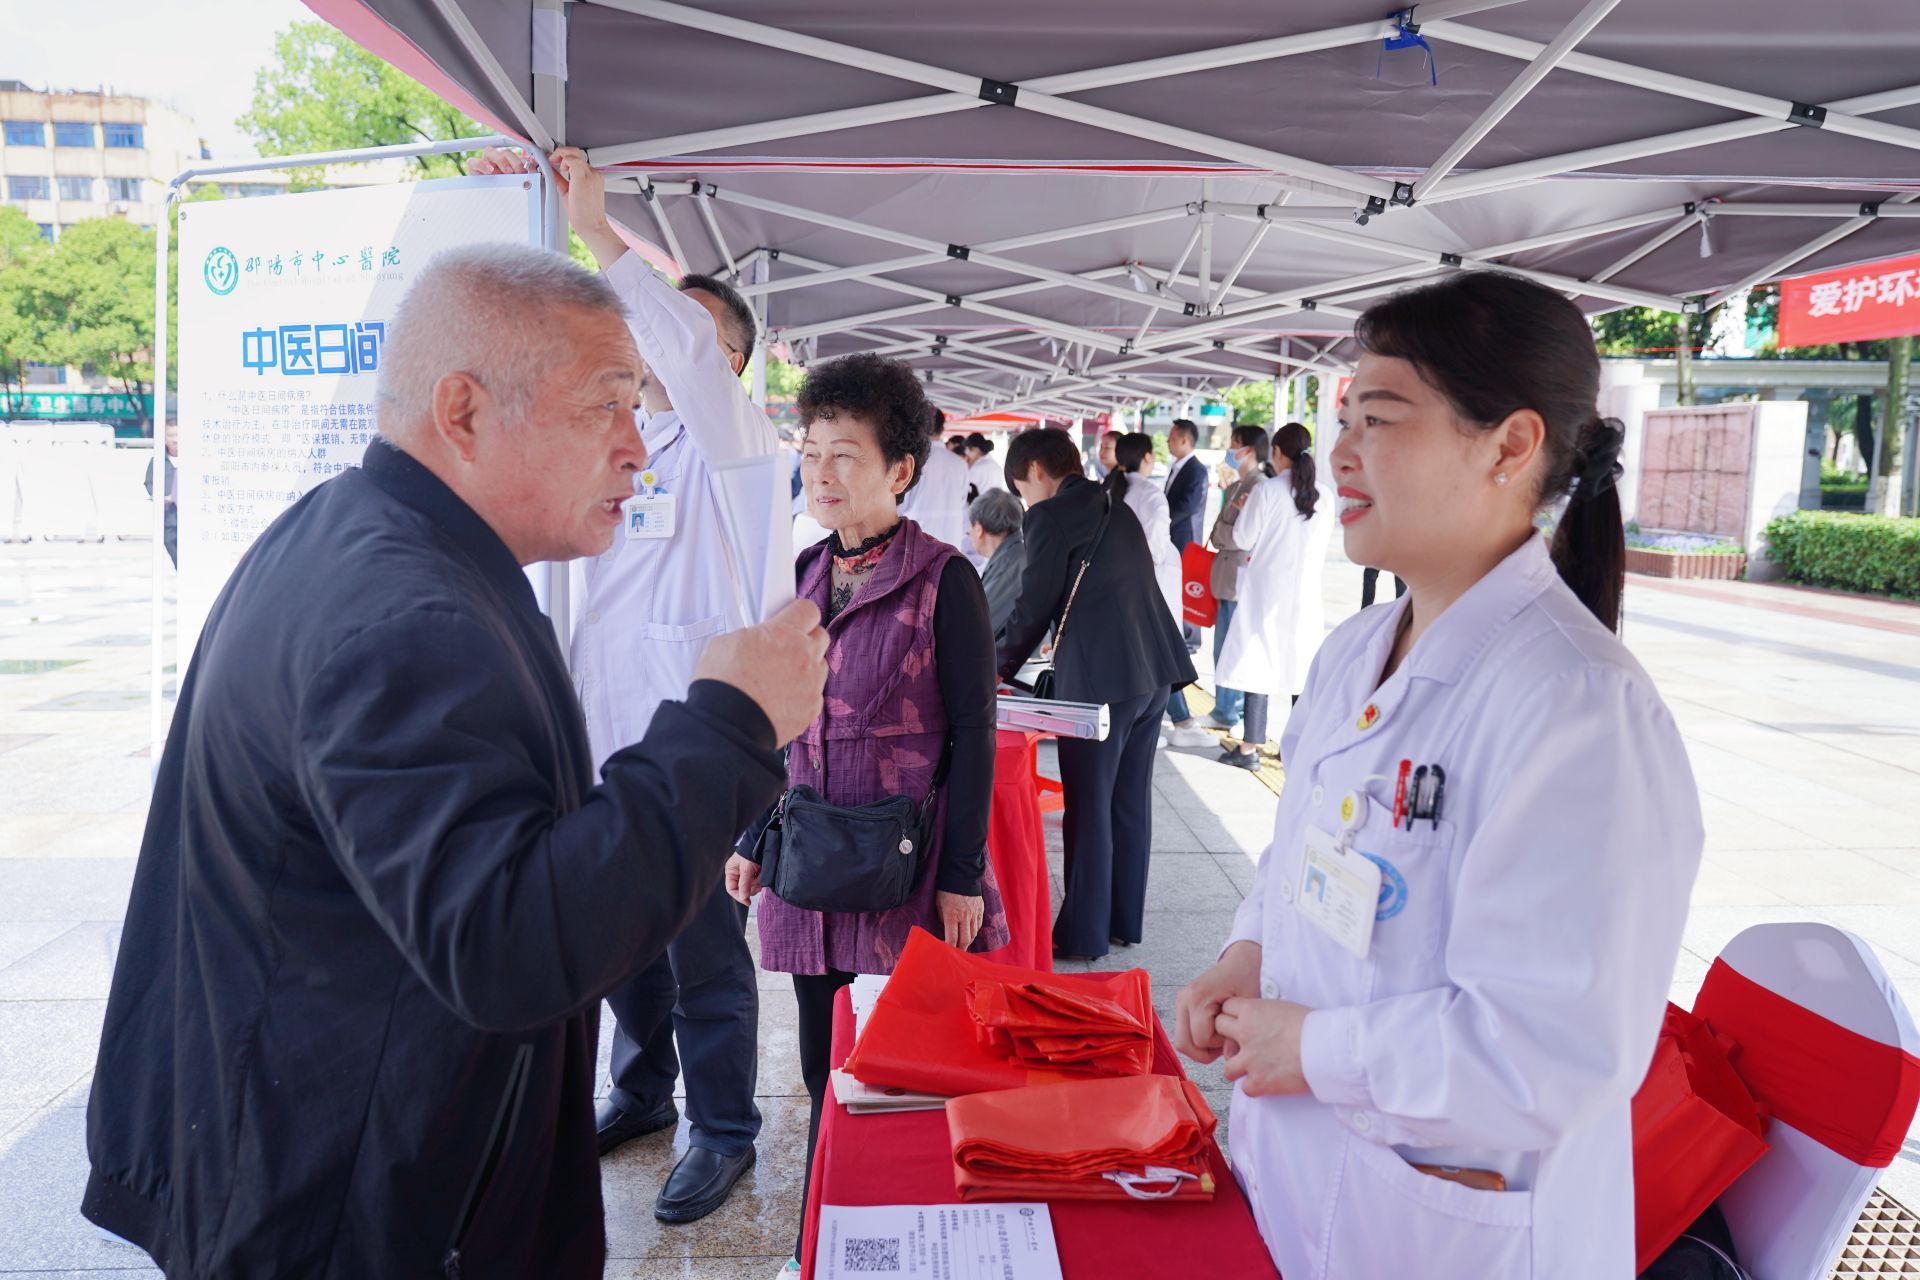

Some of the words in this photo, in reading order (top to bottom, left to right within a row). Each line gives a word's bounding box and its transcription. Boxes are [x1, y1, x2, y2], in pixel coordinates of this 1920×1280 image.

[245, 246, 401, 277] 邵陽市中心醫院
[1808, 268, 1920, 317] 爱护环
[242, 322, 385, 376] 中医日间
